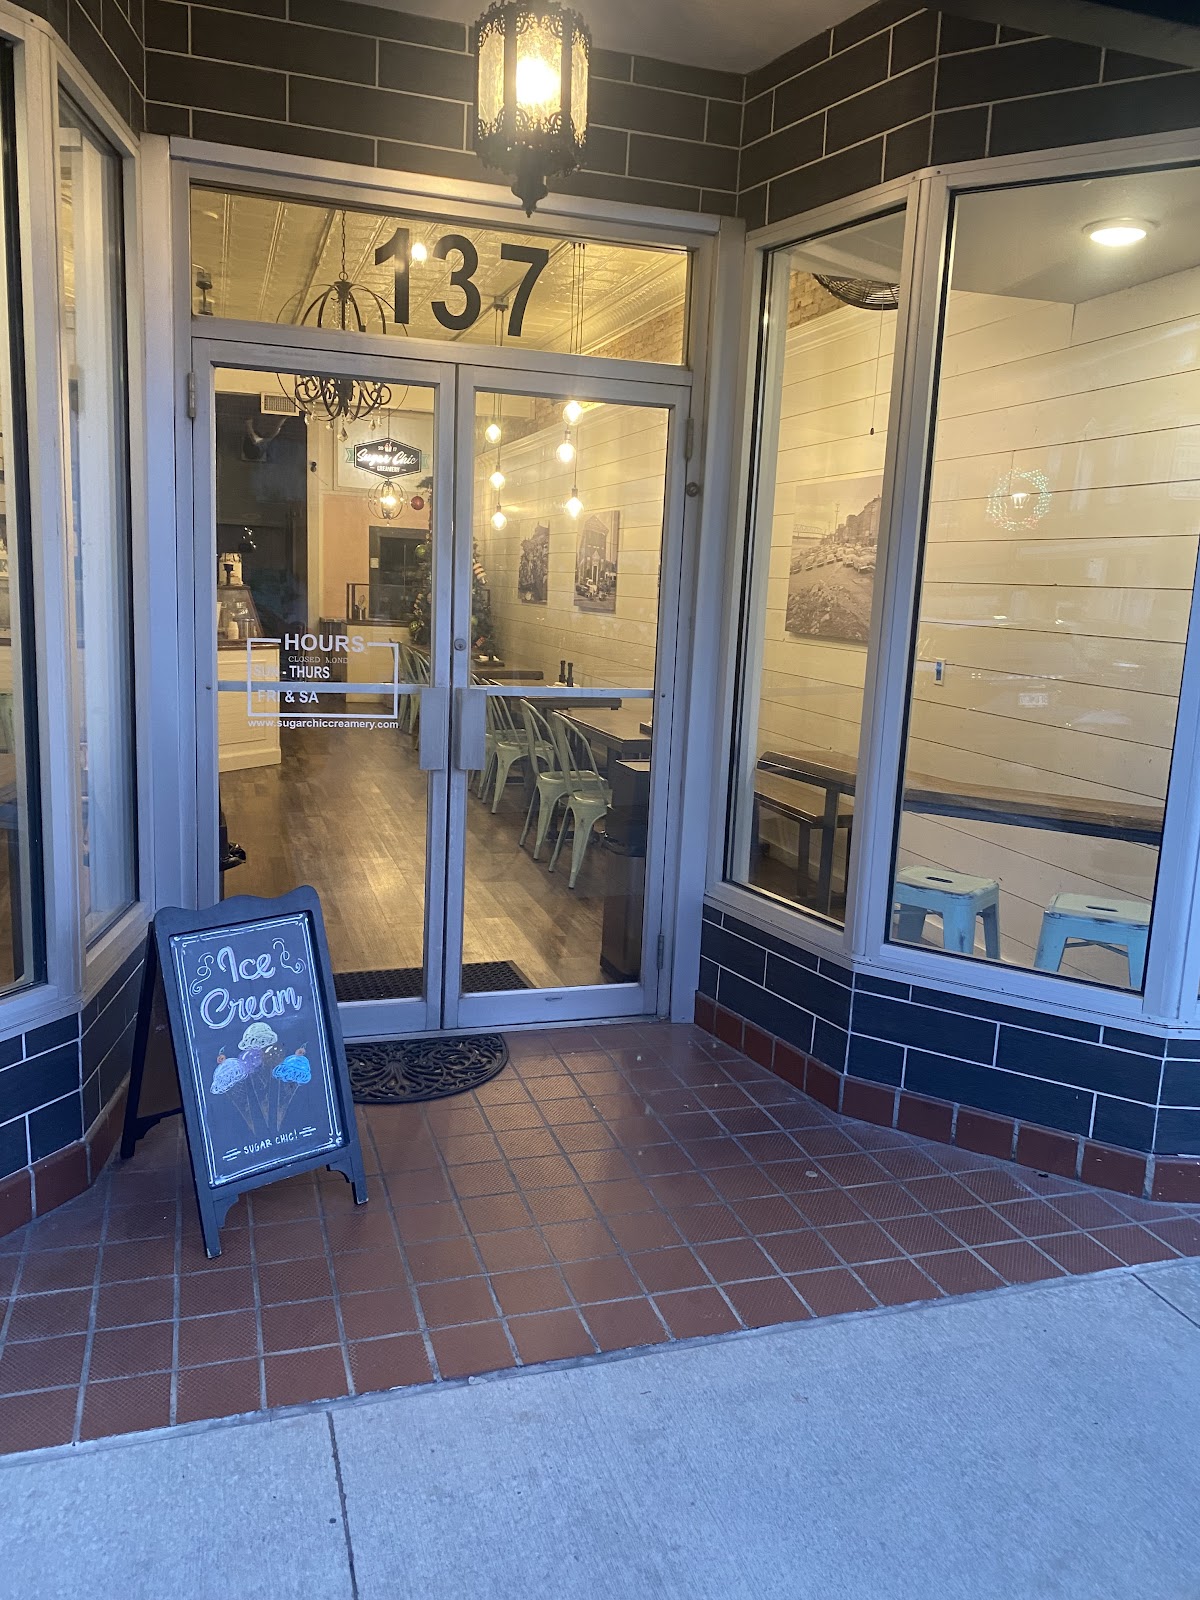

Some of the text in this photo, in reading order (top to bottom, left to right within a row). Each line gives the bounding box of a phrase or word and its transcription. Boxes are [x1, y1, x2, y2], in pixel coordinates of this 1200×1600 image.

[375, 227, 549, 337] 137
[357, 448, 418, 466] Sugar Chic
[284, 633, 365, 653] HOURS
[288, 655, 321, 663] CLOSED
[289, 665, 330, 679] THURS
[257, 690, 280, 703] FRI
[285, 689, 295, 703] &
[248, 718, 399, 731] www.sugarchiccreamery.com
[217, 946, 276, 982] Ice
[200, 987, 302, 1029] Cream
[243, 1129, 298, 1154] SUGAR CHIC!
